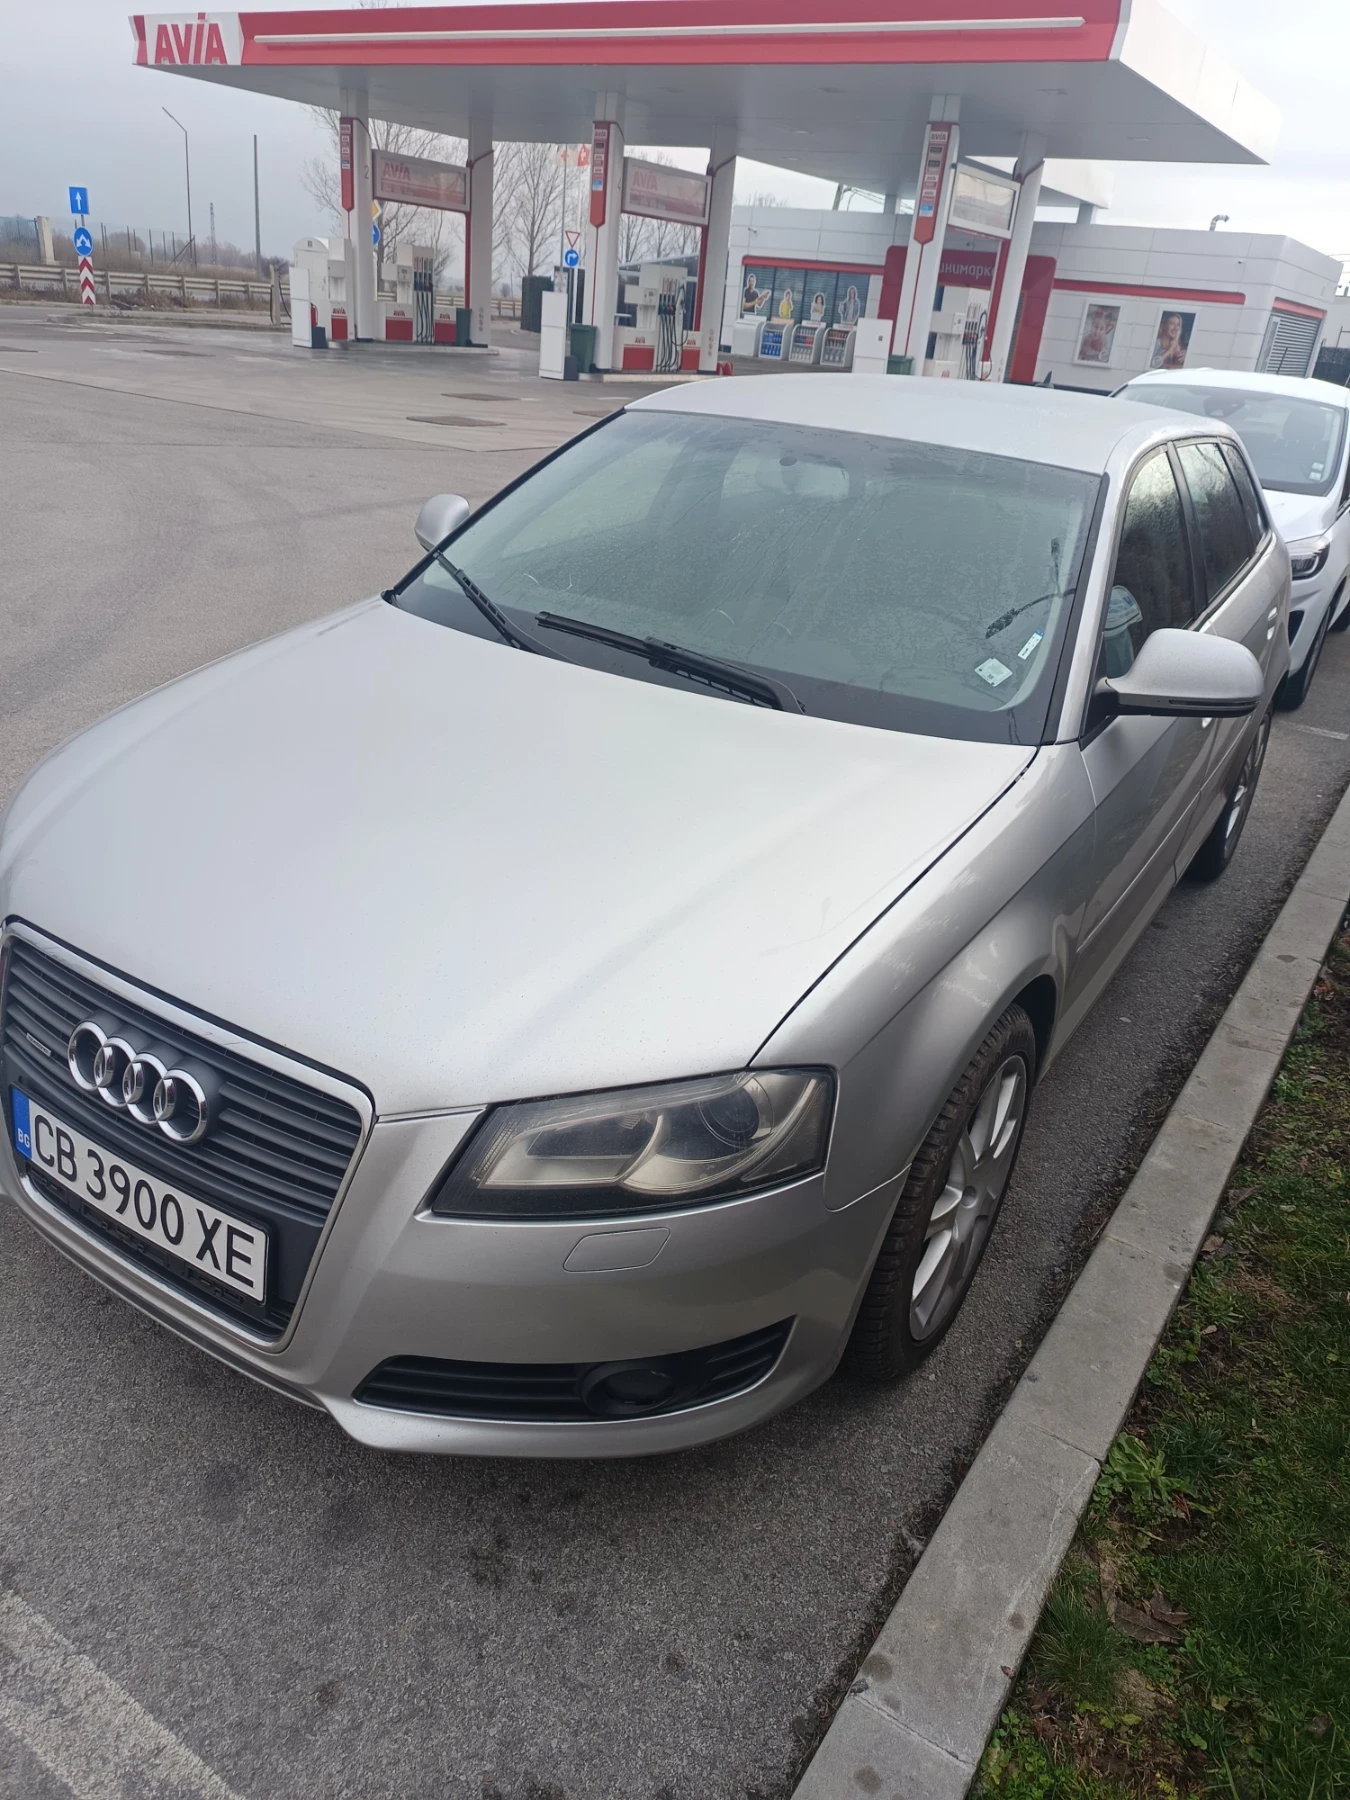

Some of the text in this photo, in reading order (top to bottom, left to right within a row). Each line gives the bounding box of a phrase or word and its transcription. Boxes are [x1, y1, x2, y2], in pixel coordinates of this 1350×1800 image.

[154, 12, 228, 65] AVIA
[364, 164, 370, 180] 2
[17, 1127, 31, 1149] BG
[34, 1114, 255, 1289] CB 3900 XE
